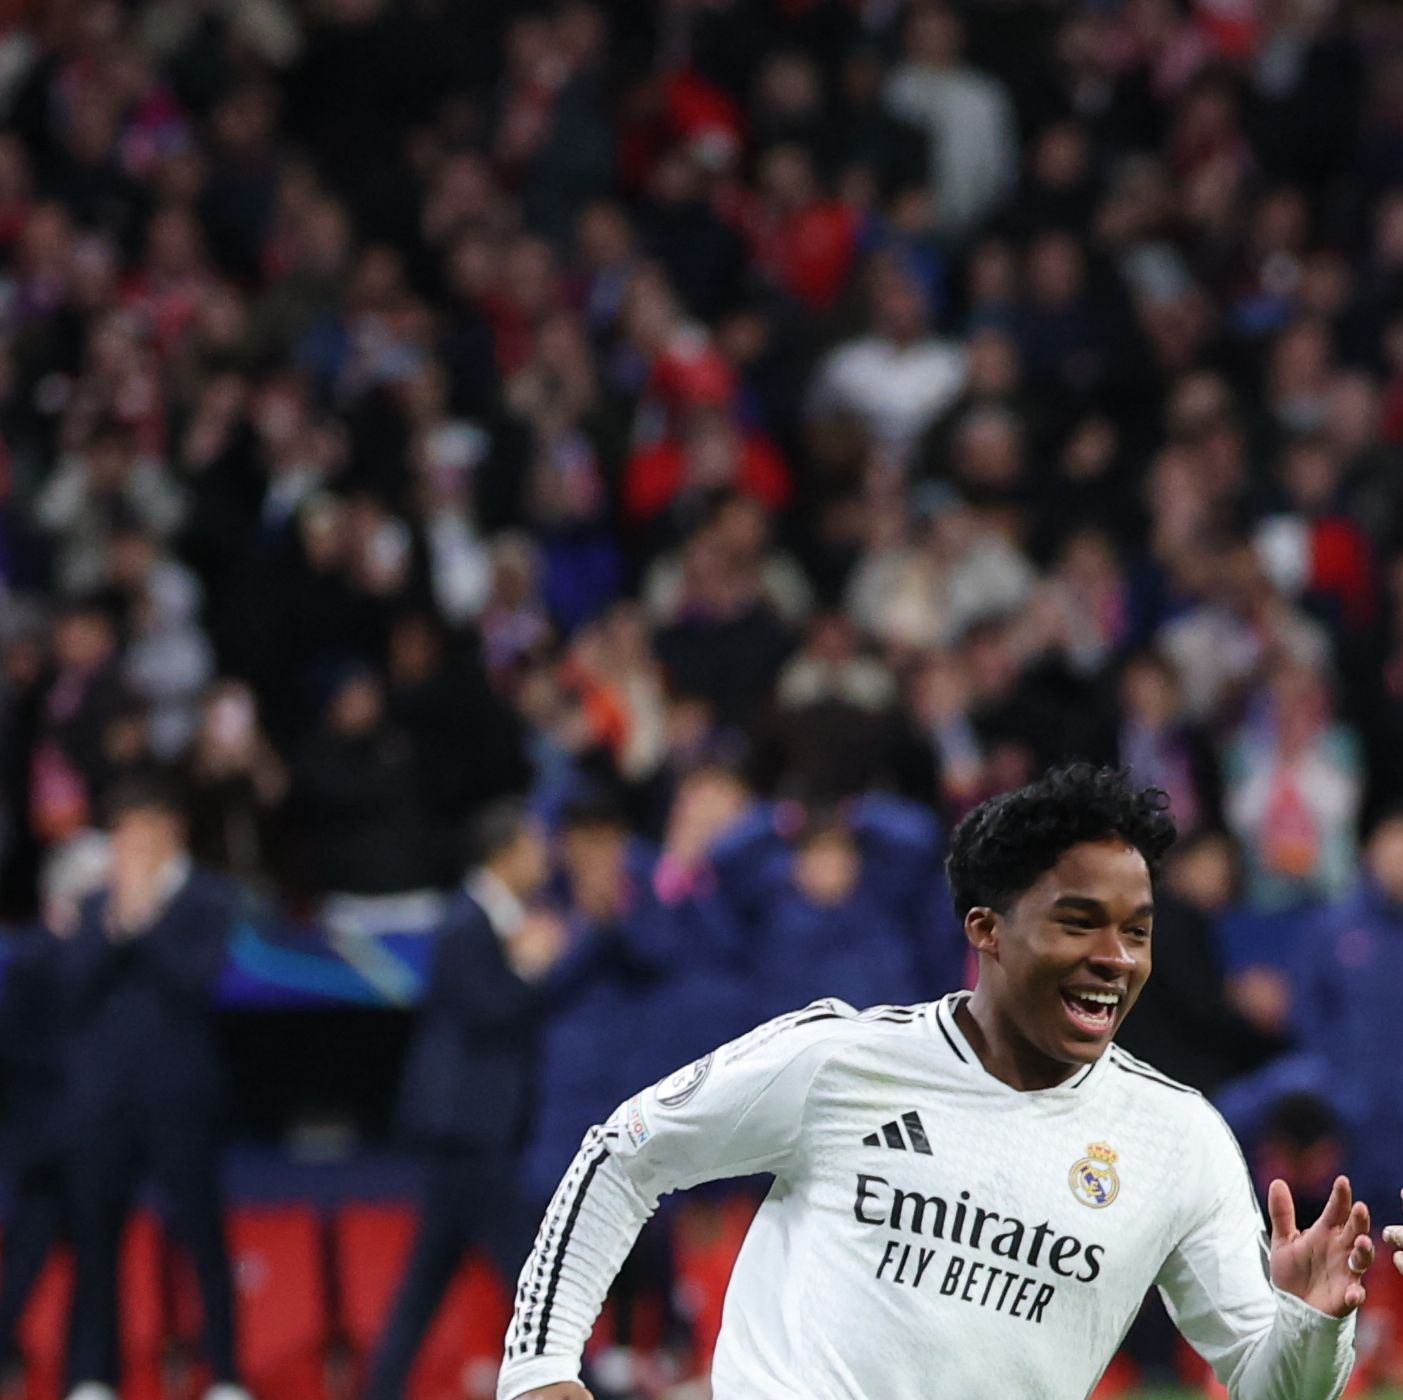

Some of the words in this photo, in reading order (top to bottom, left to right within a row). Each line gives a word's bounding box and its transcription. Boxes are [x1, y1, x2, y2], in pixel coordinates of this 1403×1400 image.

[853, 1173, 1106, 1283] Emirates
[875, 1240, 936, 1288] FLY
[939, 1255, 1056, 1324] BETTER
